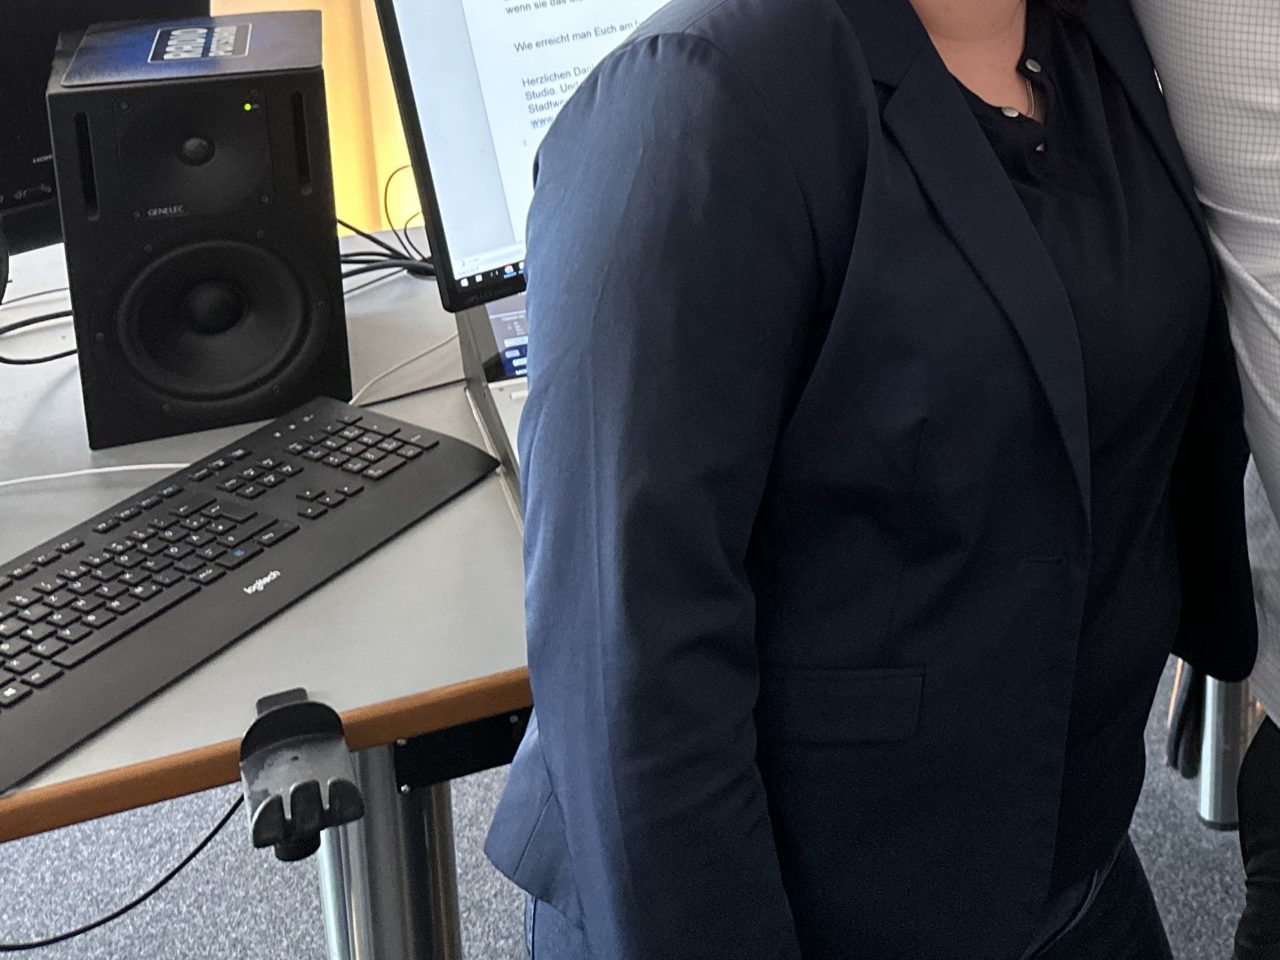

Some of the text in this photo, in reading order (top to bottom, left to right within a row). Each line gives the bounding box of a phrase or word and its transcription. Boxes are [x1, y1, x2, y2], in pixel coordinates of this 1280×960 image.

[505, 2, 532, 15] wenn
[534, 0, 548, 10] sie
[514, 41, 533, 53] Wie
[535, 33, 570, 49] erreicht
[572, 28, 592, 42] man
[594, 24, 617, 38] Euch
[619, 22, 634, 32] am
[521, 70, 572, 88] Herzlichen
[147, 204, 184, 217] GENELEC
[243, 570, 281, 594] logitech
